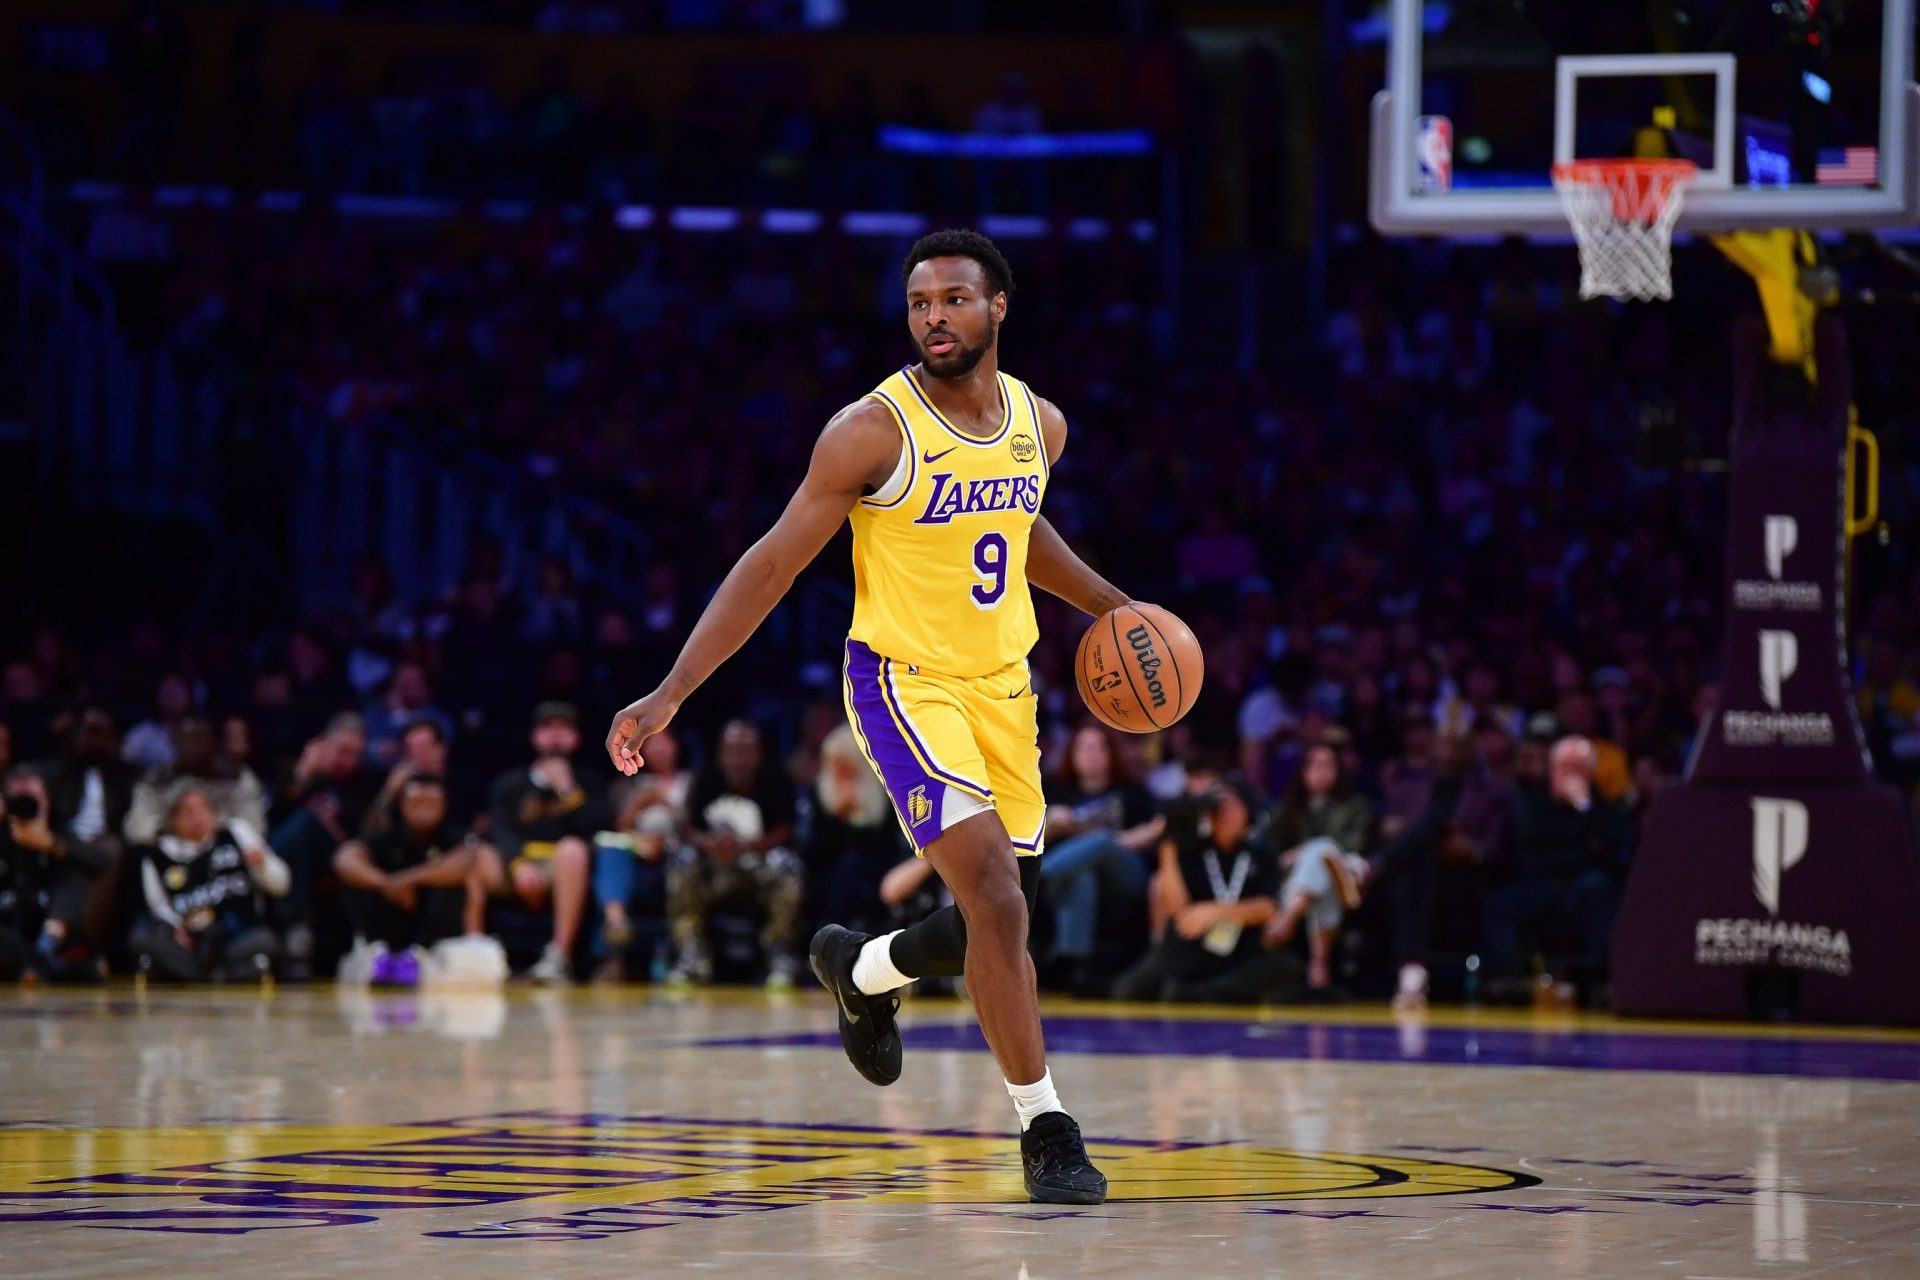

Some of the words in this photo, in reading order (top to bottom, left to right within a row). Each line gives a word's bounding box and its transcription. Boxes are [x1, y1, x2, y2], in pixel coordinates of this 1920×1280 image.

[1012, 441, 1035, 454] bibigo
[912, 472, 1040, 525] LAKERS
[969, 530, 1008, 611] 9
[1126, 623, 1167, 709] Wilson
[1696, 918, 1850, 955] PECHANGA
